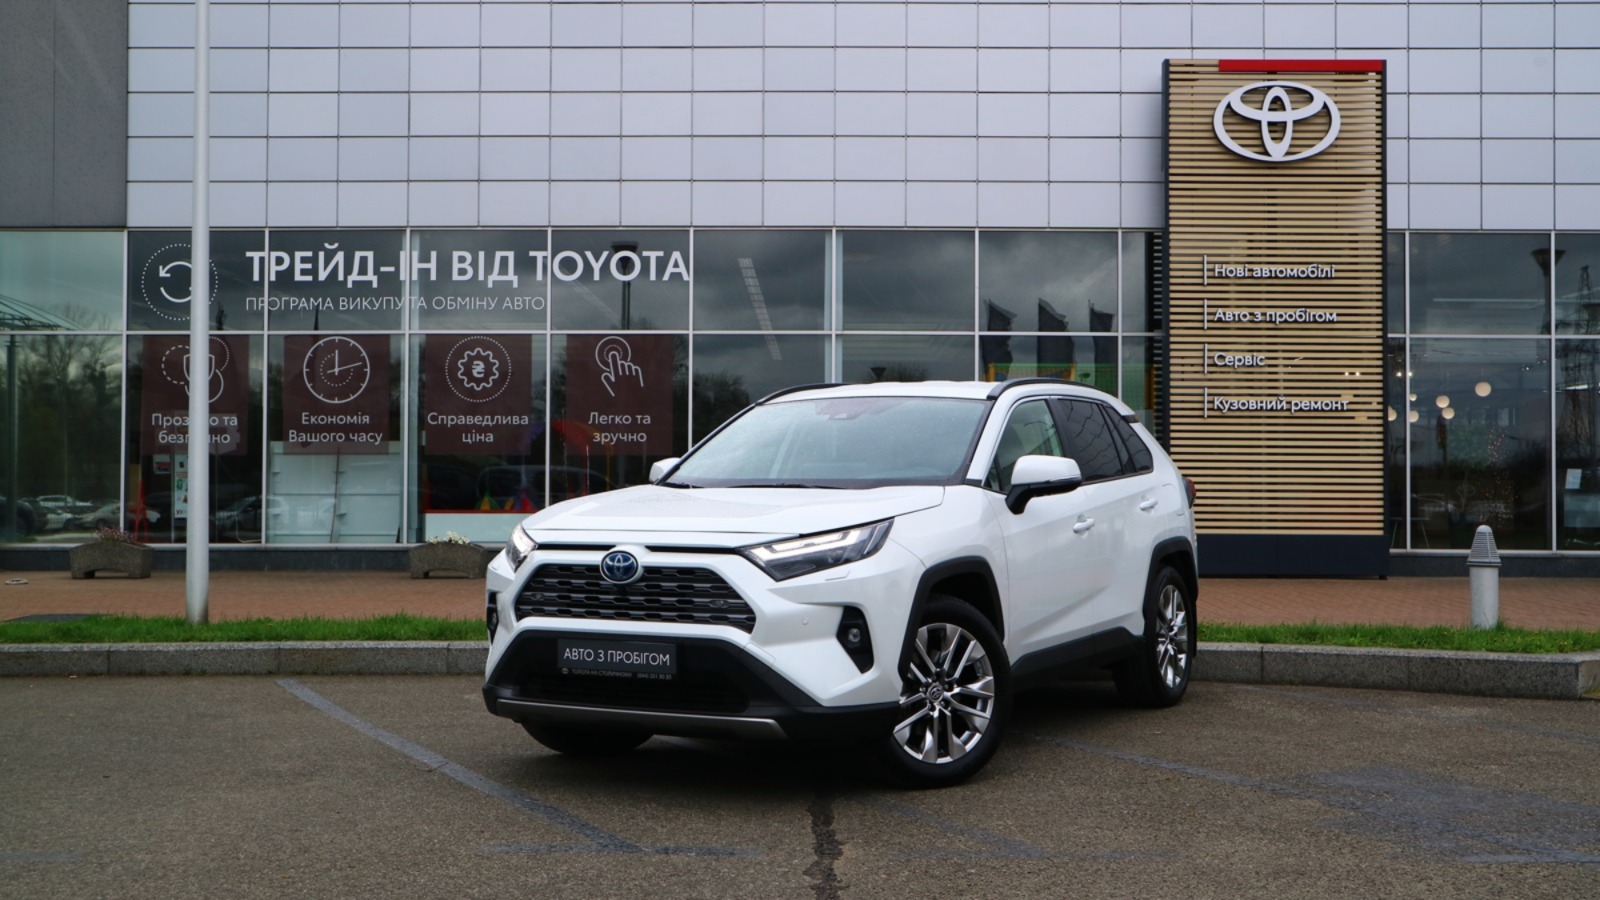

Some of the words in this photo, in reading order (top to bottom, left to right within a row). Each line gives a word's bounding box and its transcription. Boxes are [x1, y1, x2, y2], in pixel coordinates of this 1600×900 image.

[245, 242, 437, 288] ТРЕЙД-ІН
[451, 250, 518, 288] ВІД
[528, 250, 690, 281] TOYOTA
[1214, 264, 1248, 277] Нові
[1252, 264, 1336, 277] автомобілі
[246, 297, 334, 311] ПРОГРАМА
[339, 296, 405, 310] ВИКУПУ
[409, 296, 427, 310] ТА
[432, 296, 498, 310] ОБМІНУ
[502, 296, 545, 310] АВТО
[1214, 308, 1250, 322] Авто
[1253, 311, 1262, 322] з
[1266, 308, 1337, 324] пробігом
[1214, 352, 1266, 368] Сервіс
[1214, 397, 1286, 413] Кузовний
[1291, 400, 1349, 413] ремонт
[151, 413, 219, 429] Прозо
[222, 416, 238, 426] та
[302, 412, 369, 425] Економія
[427, 412, 529, 427] Справедлива
[588, 412, 632, 425] Легко
[636, 415, 651, 425] та
[288, 430, 345, 443] Вашого
[349, 432, 383, 446] часу
[462, 431, 494, 444] ціна
[592, 432, 647, 446] зручно
[563, 648, 594, 661] АВТО
[607, 650, 670, 666] ПРОБІГОМ
